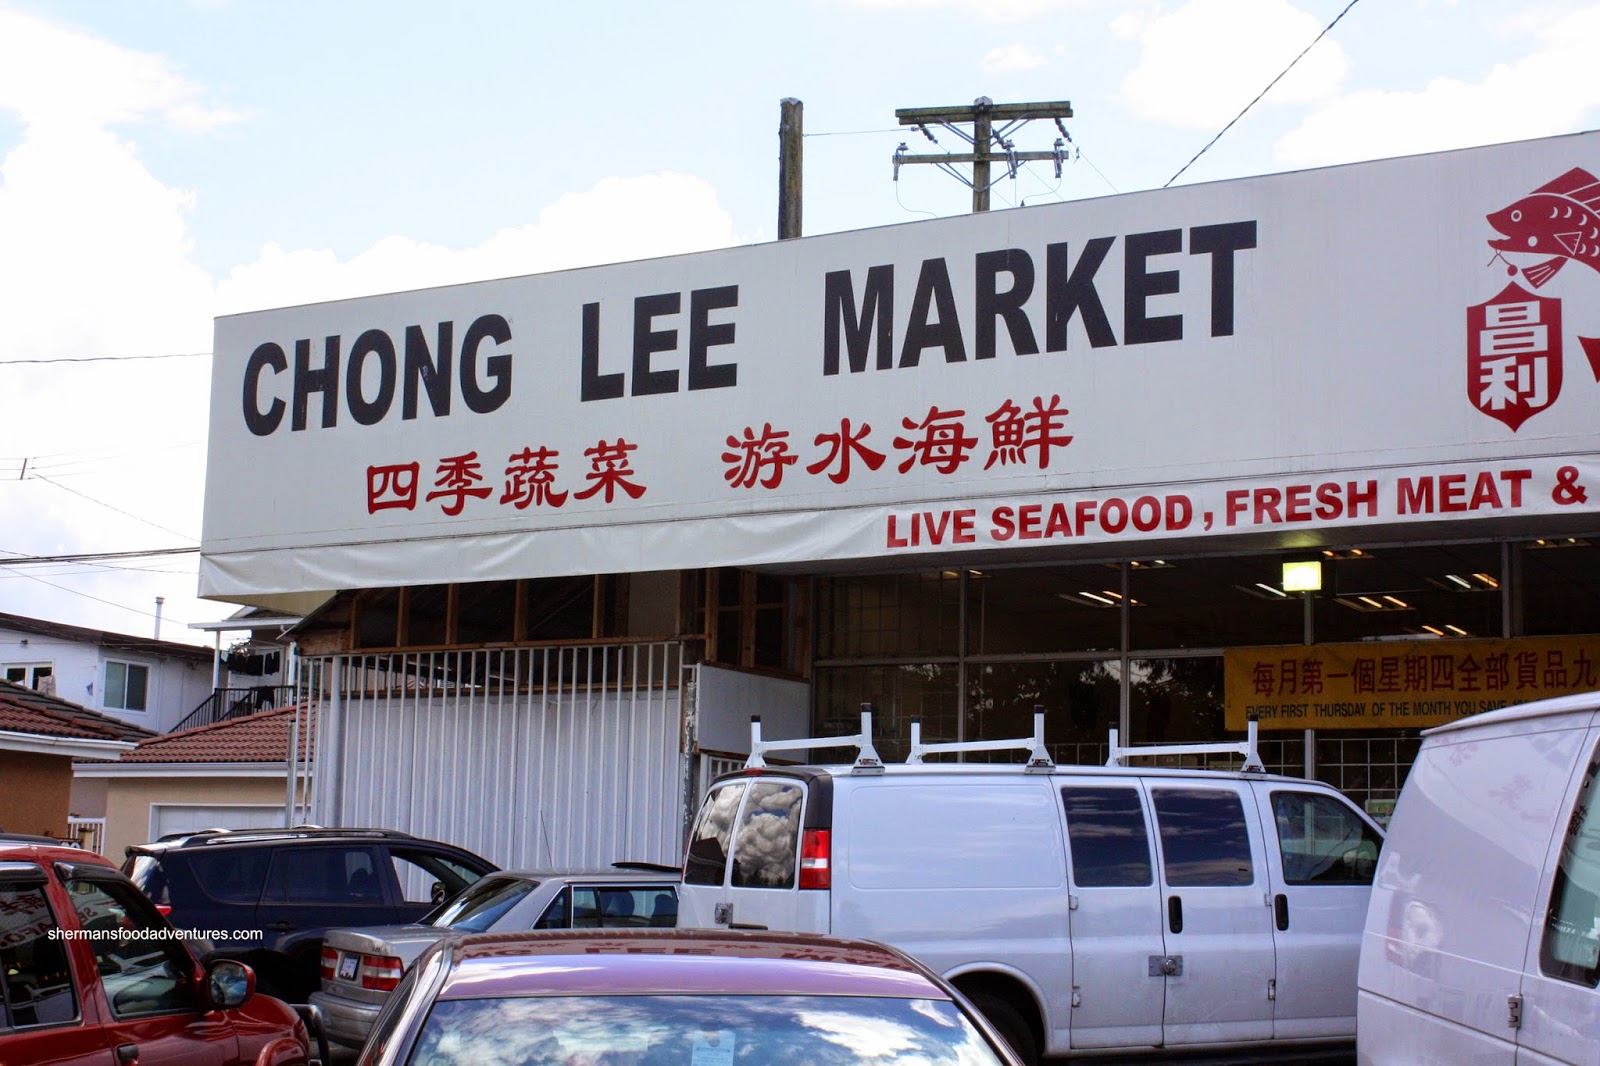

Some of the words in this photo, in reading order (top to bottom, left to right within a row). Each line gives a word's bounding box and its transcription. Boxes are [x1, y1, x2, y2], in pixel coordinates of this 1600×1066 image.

[243, 314, 512, 436] CHONG
[581, 285, 738, 402] LEE
[824, 220, 1256, 375] MARKET
[1480, 300, 1548, 411] 昌利
[367, 438, 647, 517] 四季蔬菜
[721, 394, 1073, 490] 游水海鮮
[887, 509, 976, 548] LIVE
[1226, 480, 1378, 527] FRESH
[1398, 469, 1532, 515] MEAT
[1551, 466, 1588, 505] &
[1246, 705, 1278, 719] EVERY
[1281, 703, 1309, 718] FIRST
[1313, 702, 1367, 718] THURSDAY
[1372, 702, 1386, 716] OF
[1390, 701, 1410, 716] THE
[1413, 700, 1452, 716] MONTH
[1454, 700, 1476, 715] YOU
